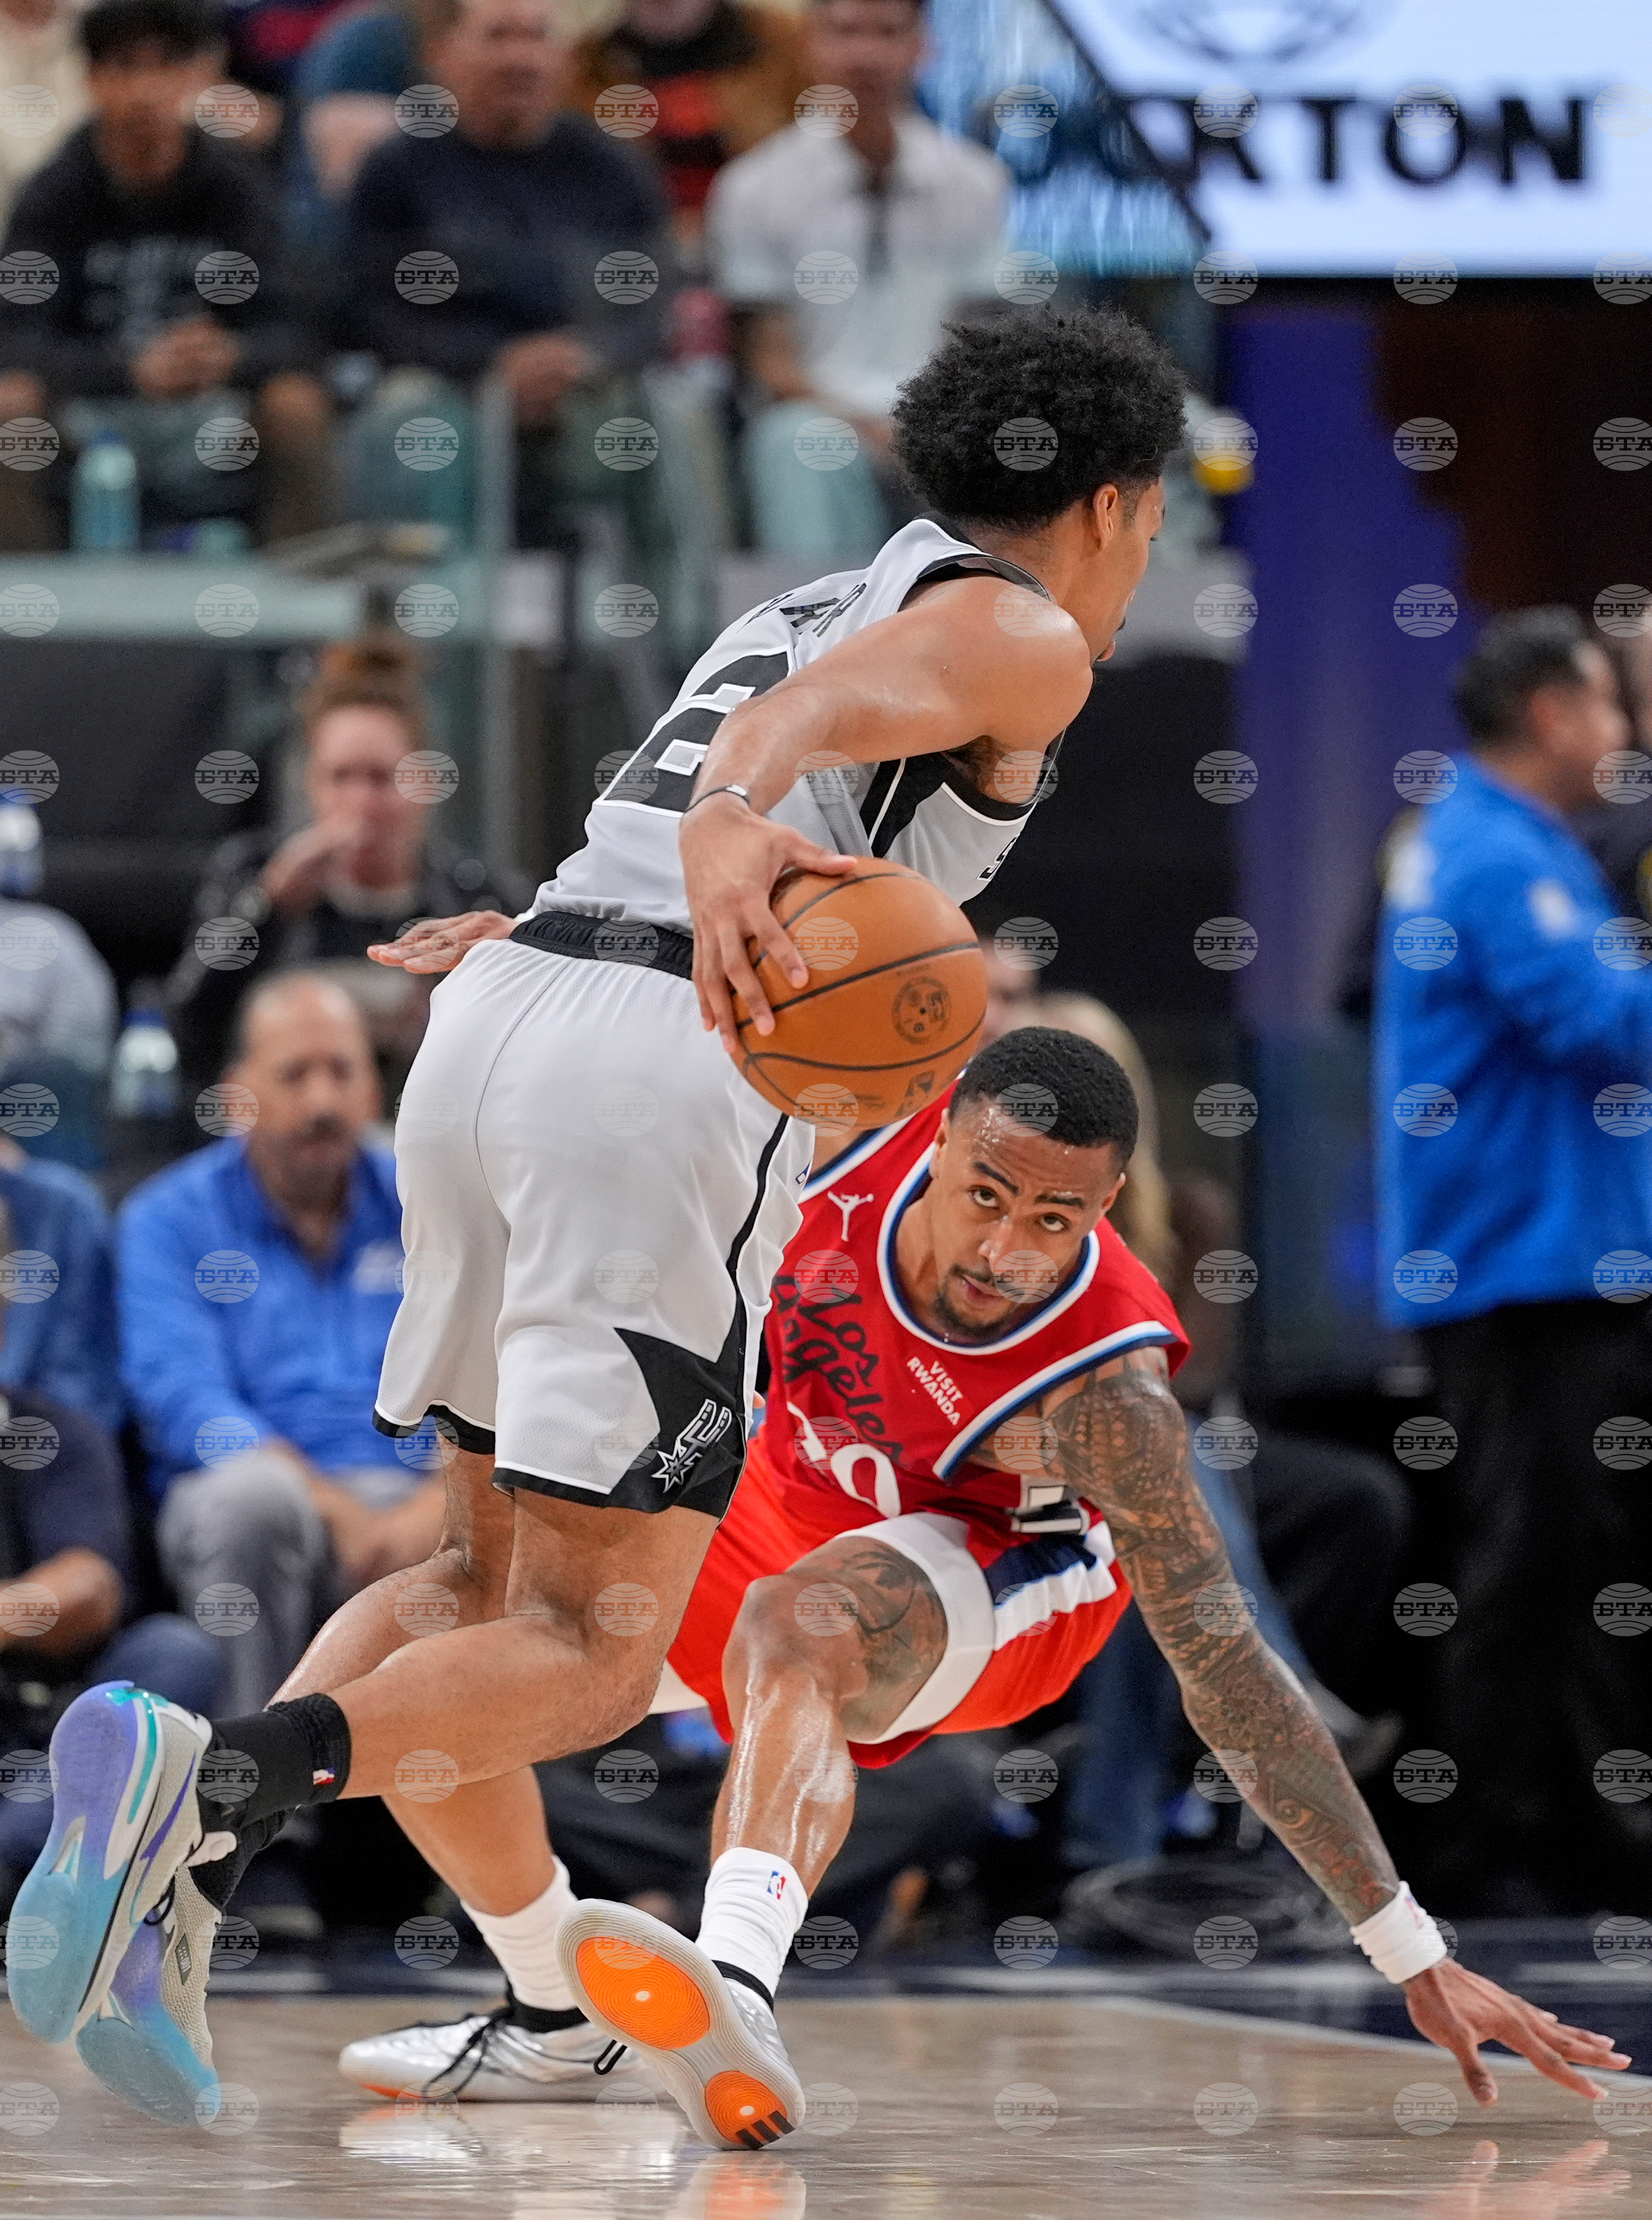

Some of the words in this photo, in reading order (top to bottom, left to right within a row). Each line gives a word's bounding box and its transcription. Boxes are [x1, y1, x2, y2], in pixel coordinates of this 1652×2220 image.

[797, 1285, 879, 1388] Los
[906, 1356, 961, 1426] RWANDA
[930, 1360, 963, 1402] VISIT
